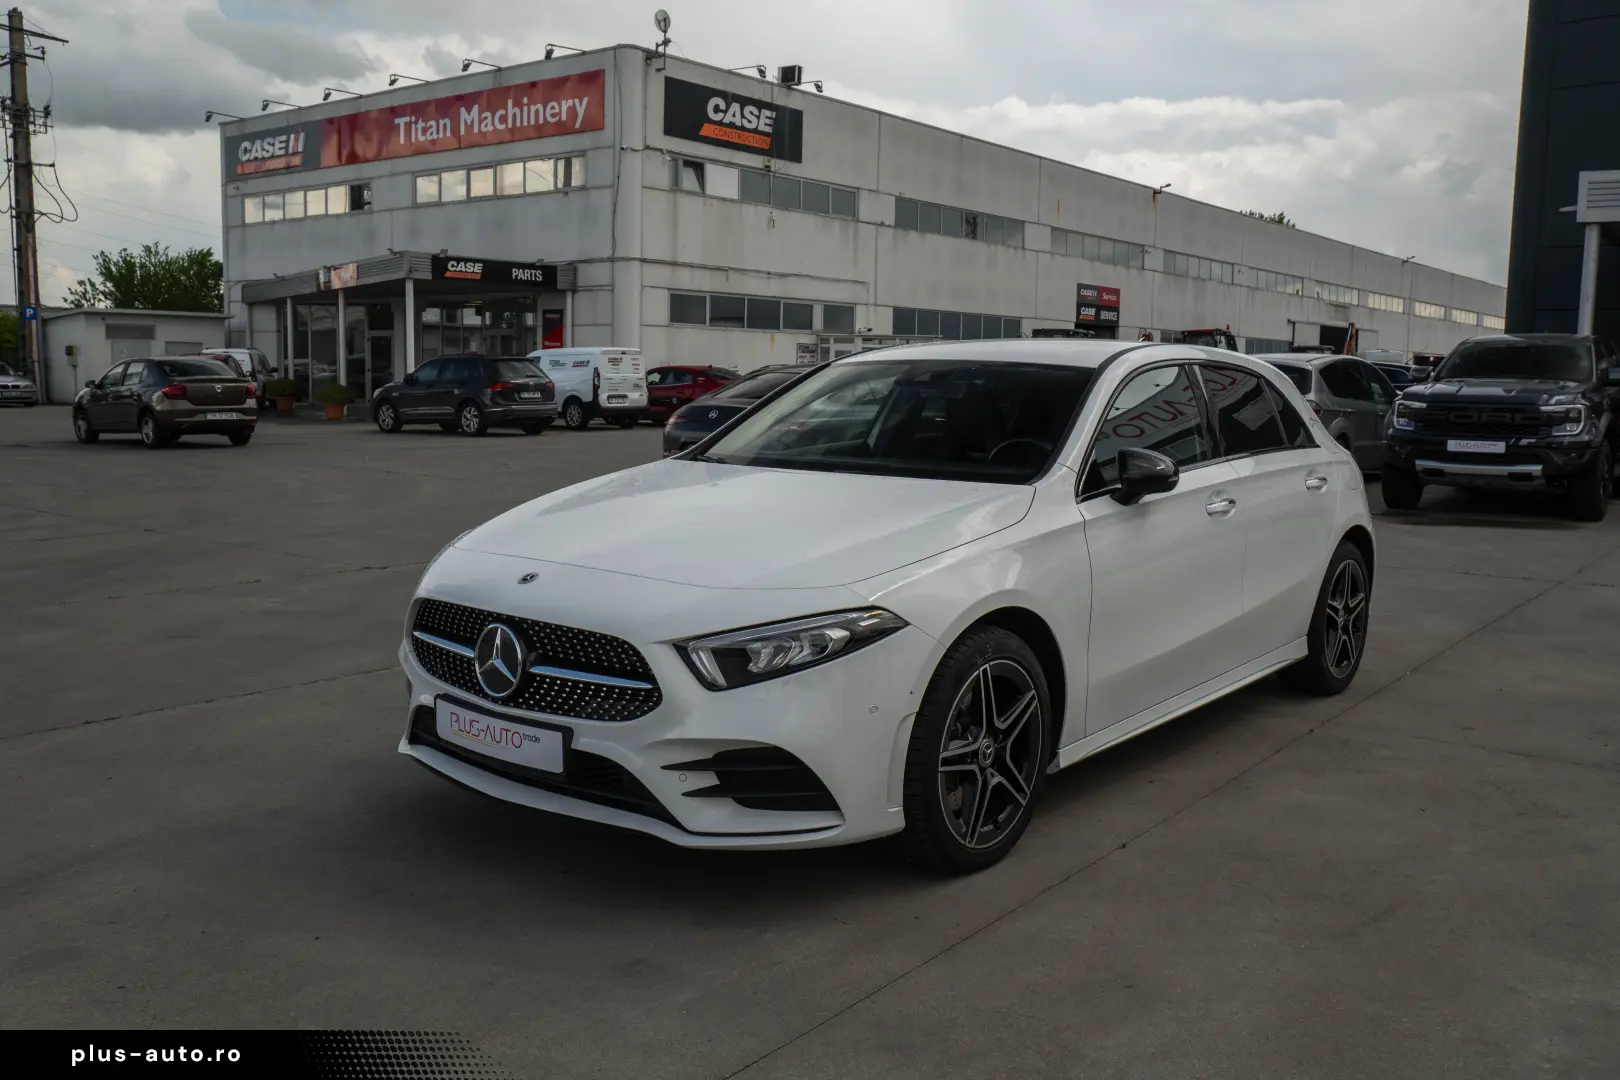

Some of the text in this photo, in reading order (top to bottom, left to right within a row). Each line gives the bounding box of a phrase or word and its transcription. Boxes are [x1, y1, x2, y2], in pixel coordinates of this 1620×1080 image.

[394, 96, 589, 145] Titan Machinery
[706, 96, 776, 133] CASE
[238, 134, 289, 162] CASE
[712, 128, 768, 146] CONSTRUCTION
[447, 260, 543, 282] CASE PARTS
[26, 308, 34, 318] P
[1080, 307, 1096, 315] CASE
[1100, 310, 1118, 320] SERVICE
[450, 711, 541, 749] PLUS-AUTO trade
